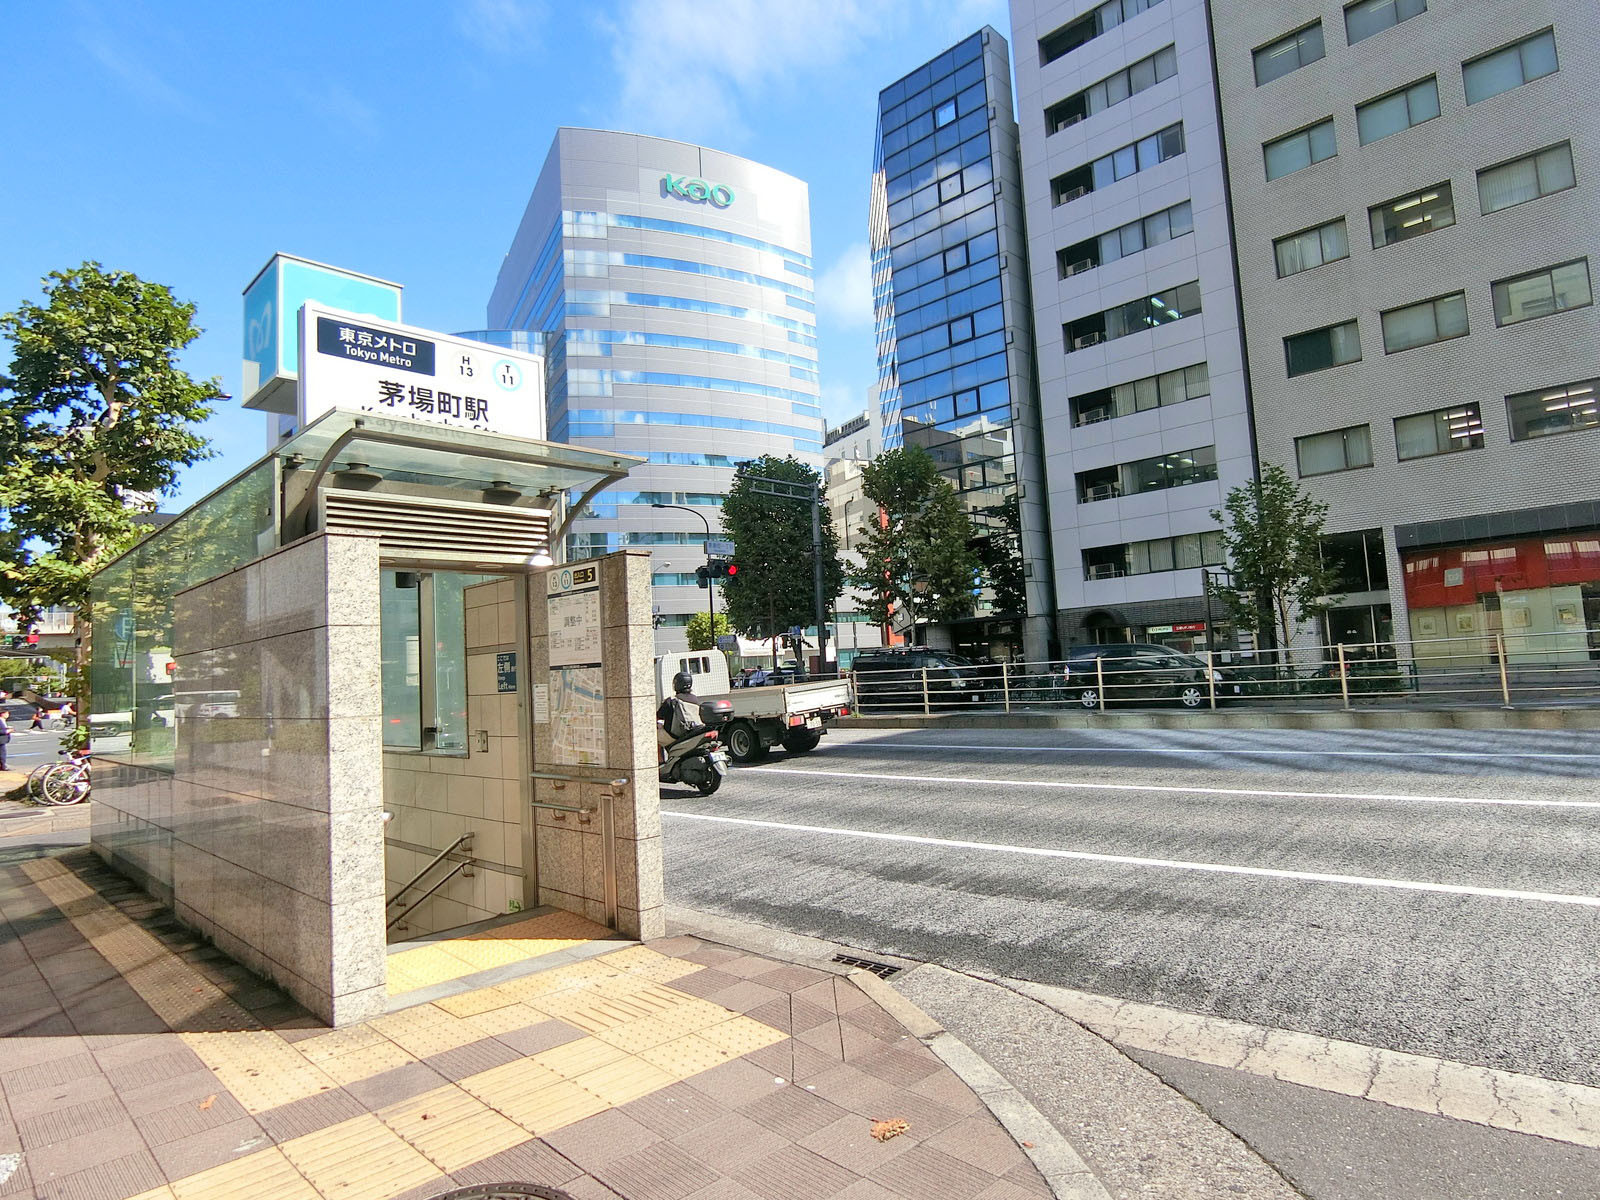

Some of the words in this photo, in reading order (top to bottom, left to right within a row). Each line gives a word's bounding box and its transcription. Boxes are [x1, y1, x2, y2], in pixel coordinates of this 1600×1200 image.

[339, 327, 416, 357] 東京メトロ
[344, 344, 378, 361] Tokyo
[380, 351, 412, 367] Metro
[462, 355, 470, 365] H
[460, 365, 473, 377] 13
[505, 364, 511, 373] T
[502, 374, 513, 385] 11
[378, 380, 489, 423] 茅場町駅
[587, 568, 593, 581] 5
